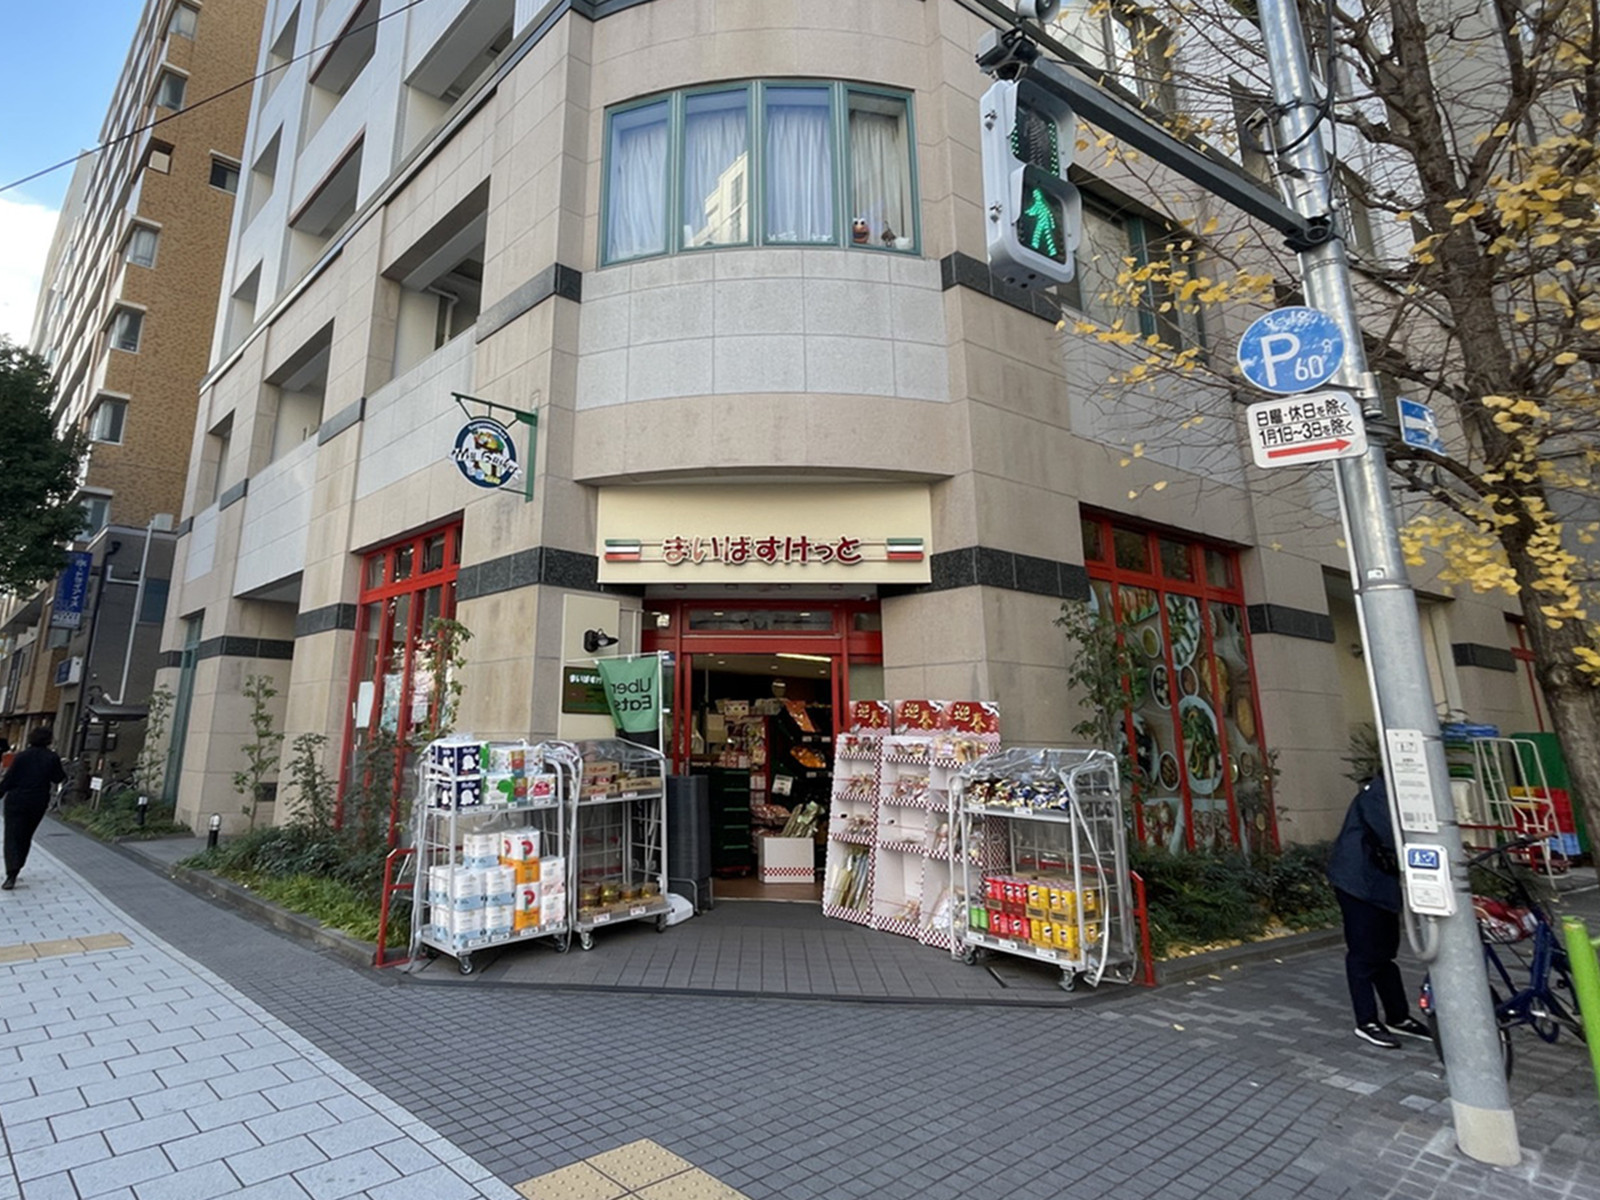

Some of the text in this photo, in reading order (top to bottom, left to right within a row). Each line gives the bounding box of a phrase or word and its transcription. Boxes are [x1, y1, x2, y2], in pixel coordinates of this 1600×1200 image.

[1260, 332, 1300, 388] P
[1256, 398, 1350, 427] 日曜・休日を除く
[662, 534, 864, 566] まいばすけっと
[904, 702, 934, 731] 迎春
[953, 703, 987, 734] 迎春
